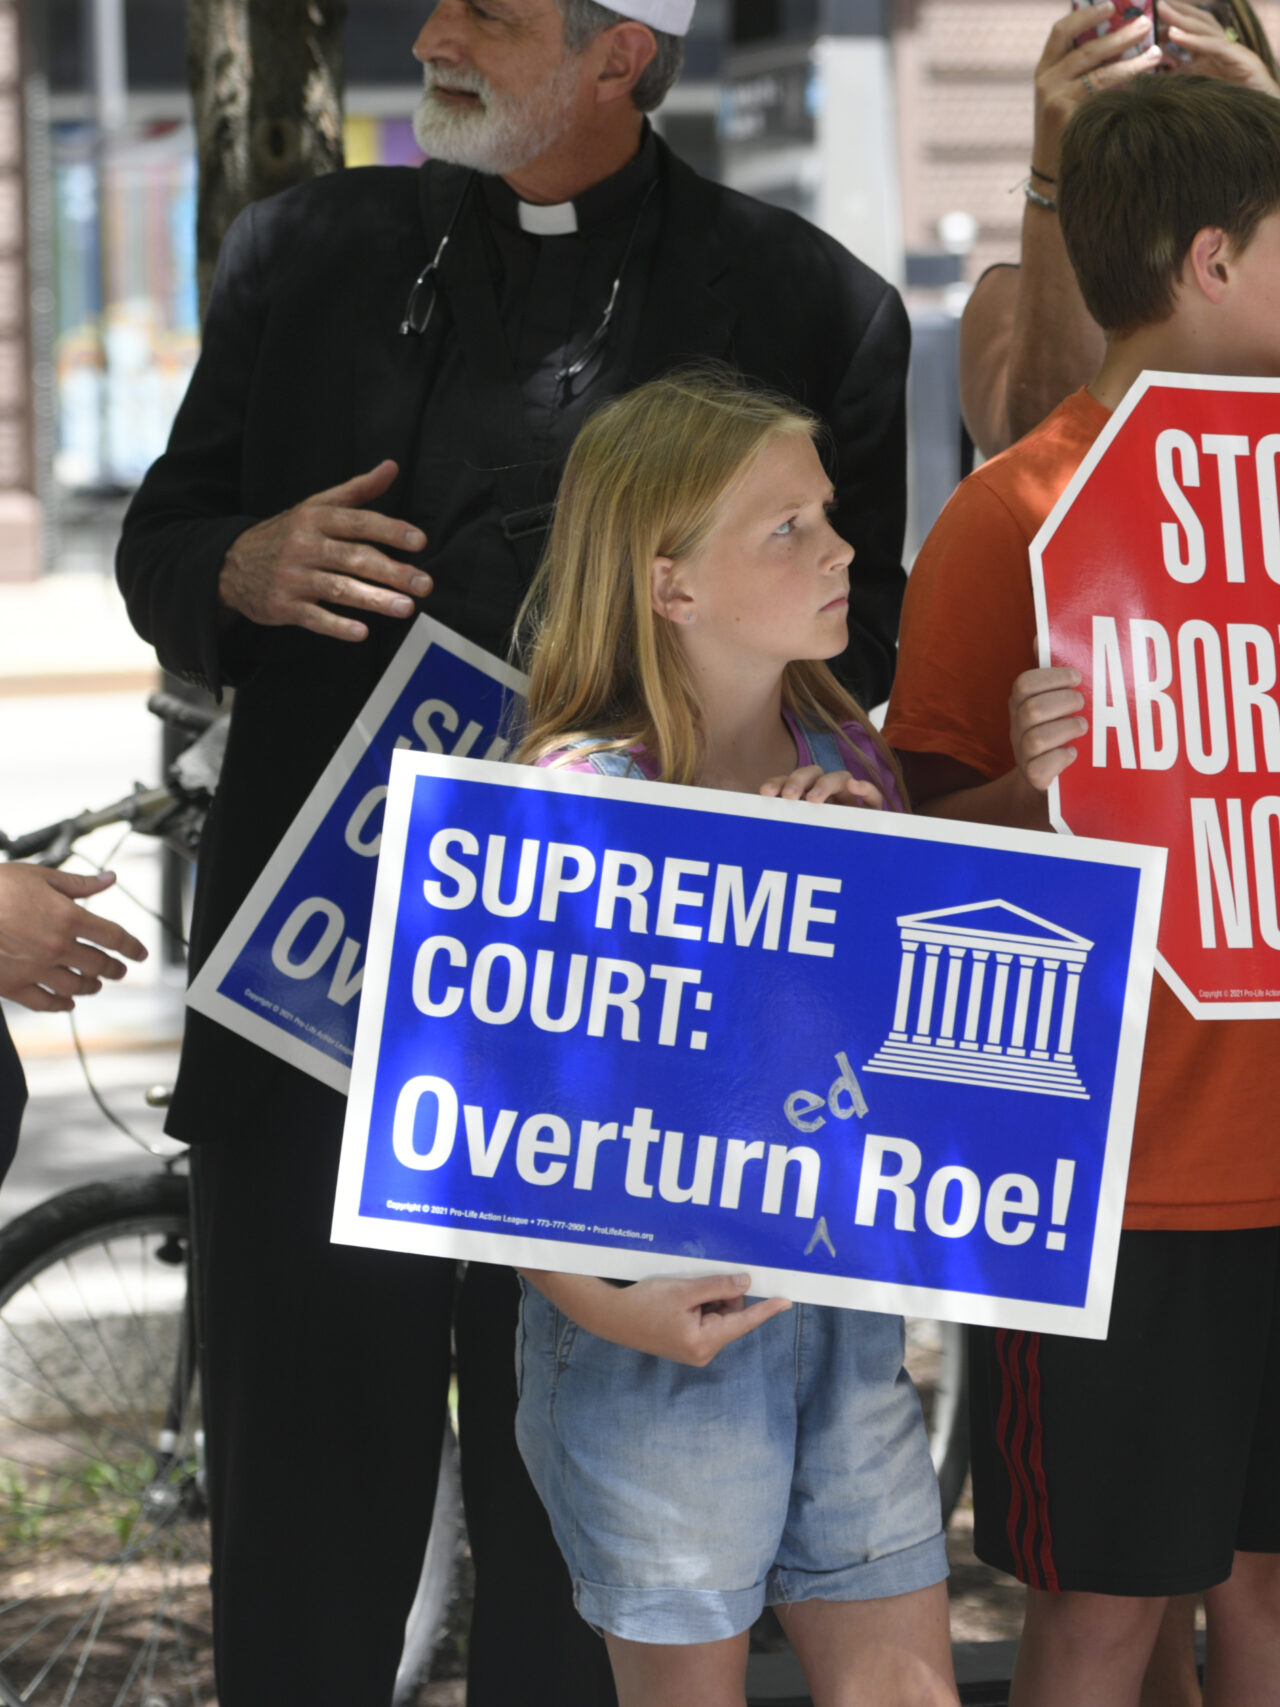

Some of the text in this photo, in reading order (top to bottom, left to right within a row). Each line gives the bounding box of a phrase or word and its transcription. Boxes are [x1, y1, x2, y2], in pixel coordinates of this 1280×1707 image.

[423, 828, 841, 957] SUPREME
[412, 936, 712, 1050] COURT:
[1199, 989, 1223, 999] Copyright
[1230, 989, 1244, 998] 2021
[1244, 988, 1264, 998] Pro-Life
[784, 1051, 869, 1133] ed
[392, 1075, 1075, 1250] Overturn Roe!
[386, 1200, 422, 1215] Copyright
[430, 1205, 448, 1216] 2021
[449, 1208, 478, 1220] Pro-Life
[479, 1210, 502, 1222] Action
[503, 1213, 529, 1226] League
[536, 1217, 586, 1232] 773-777-2900
[593, 1225, 654, 1242] ProLifeAction.org
